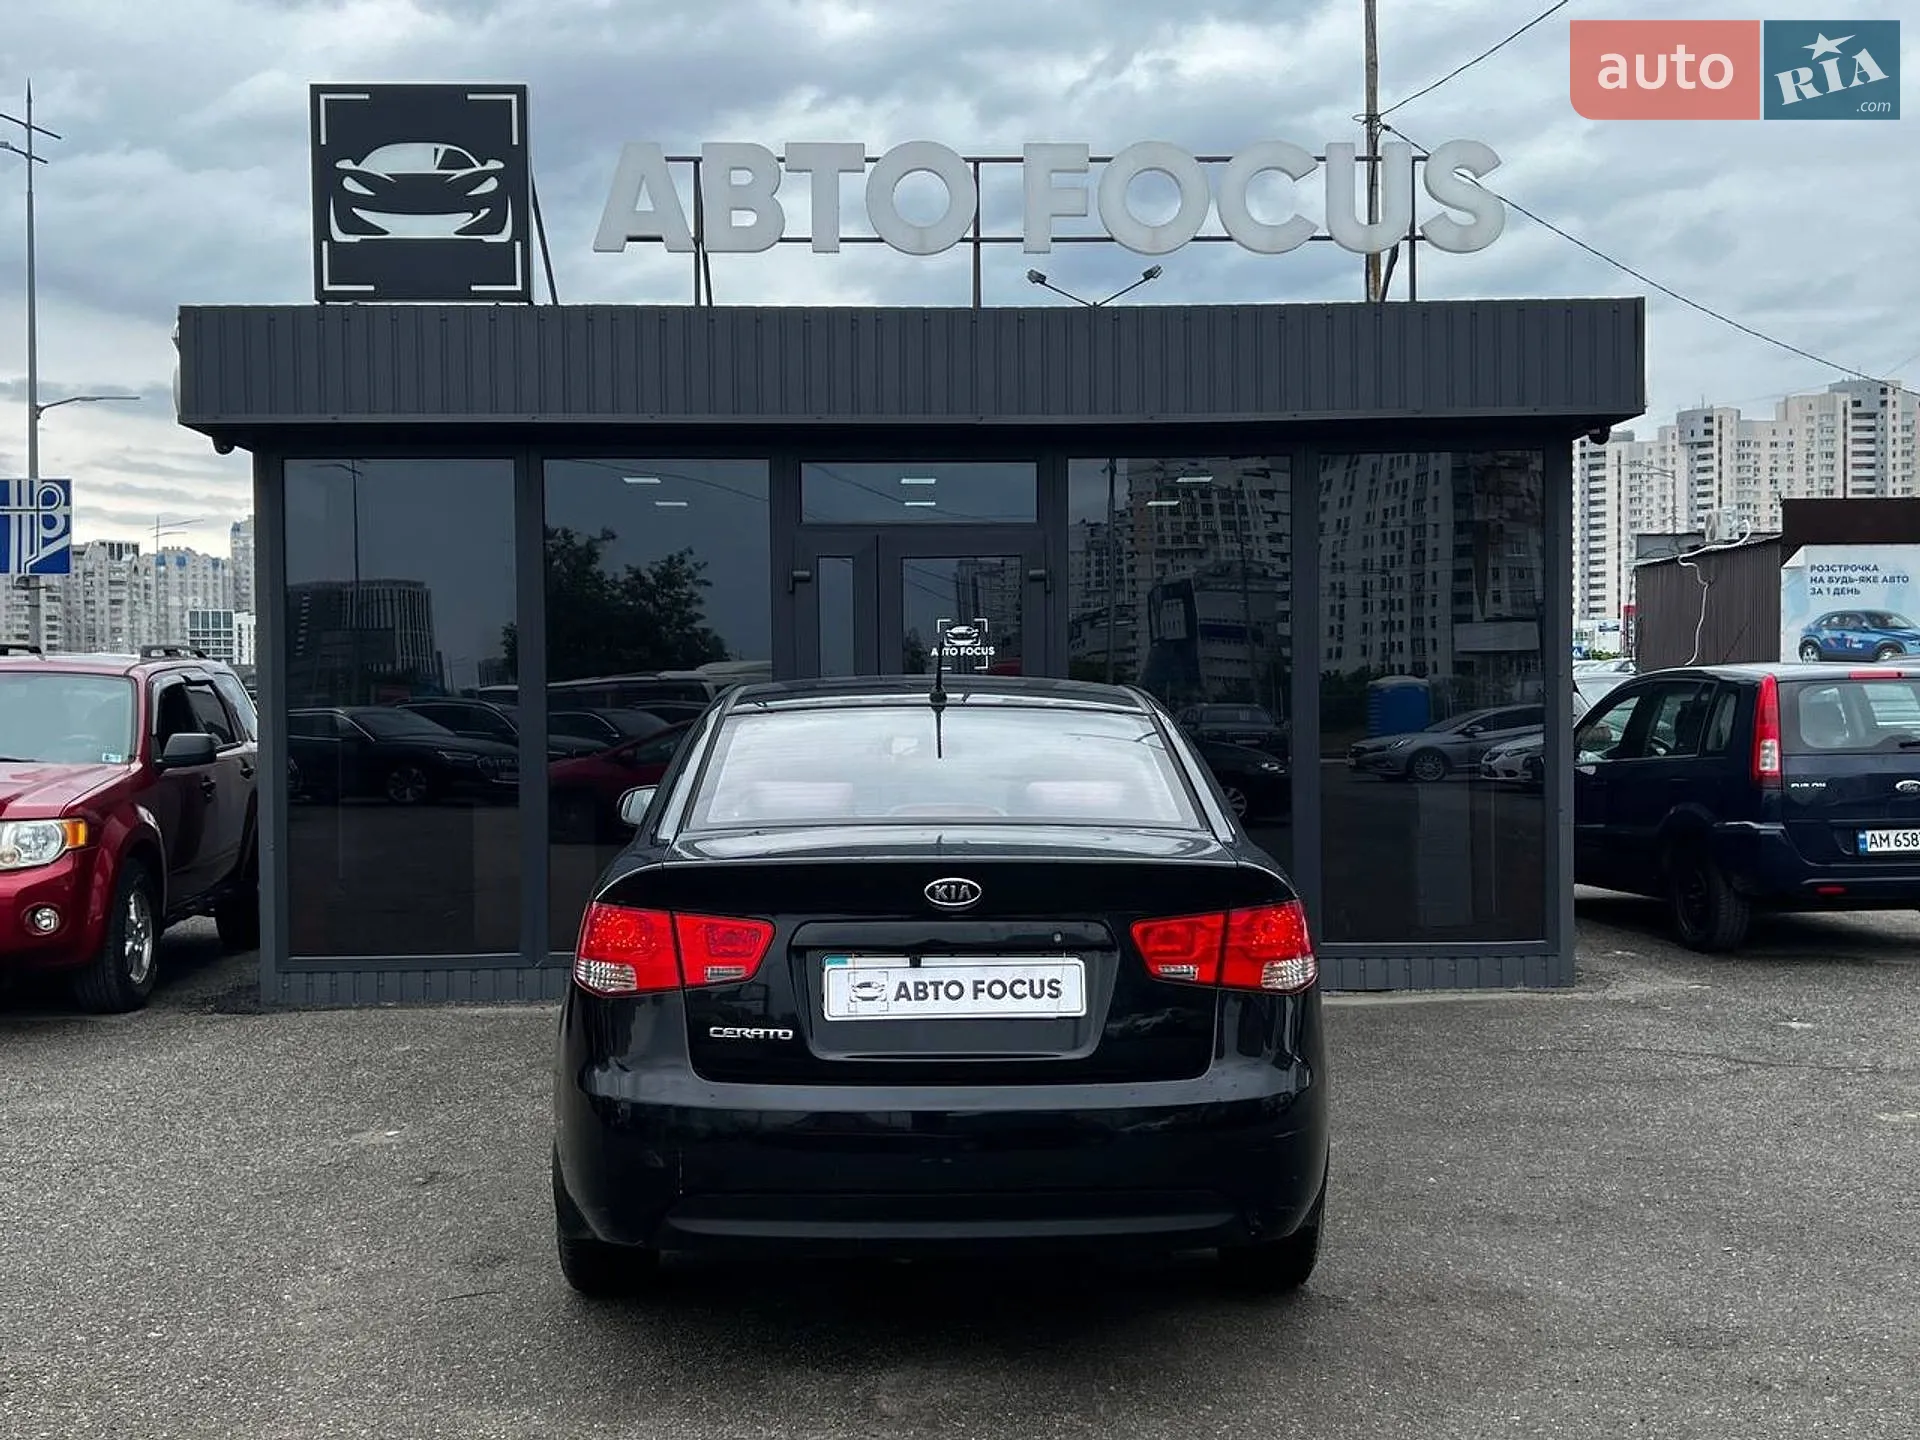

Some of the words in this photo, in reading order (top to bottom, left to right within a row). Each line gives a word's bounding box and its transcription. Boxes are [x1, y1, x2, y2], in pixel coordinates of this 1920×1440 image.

[593, 140, 977, 256] АВТО
[1023, 138, 1506, 255] FOCUS
[1810, 564, 1879, 573] РОЗСТРОЧКА
[1810, 575, 1825, 584] НА
[1827, 575, 1879, 585] БУДЬ-ЯКЕ
[1881, 575, 1910, 584] АВТО
[1810, 587, 1824, 596] ЗА
[1833, 587, 1861, 597] ДЕНЬ
[960, 646, 996, 656] FOCUS
[1869, 832, 1891, 849] AM
[1894, 832, 1920, 848] 658
[935, 885, 972, 901] KIA
[894, 979, 965, 1002] АВТО
[972, 978, 1063, 1000] FOCUS
[708, 1026, 794, 1041] CERATO
